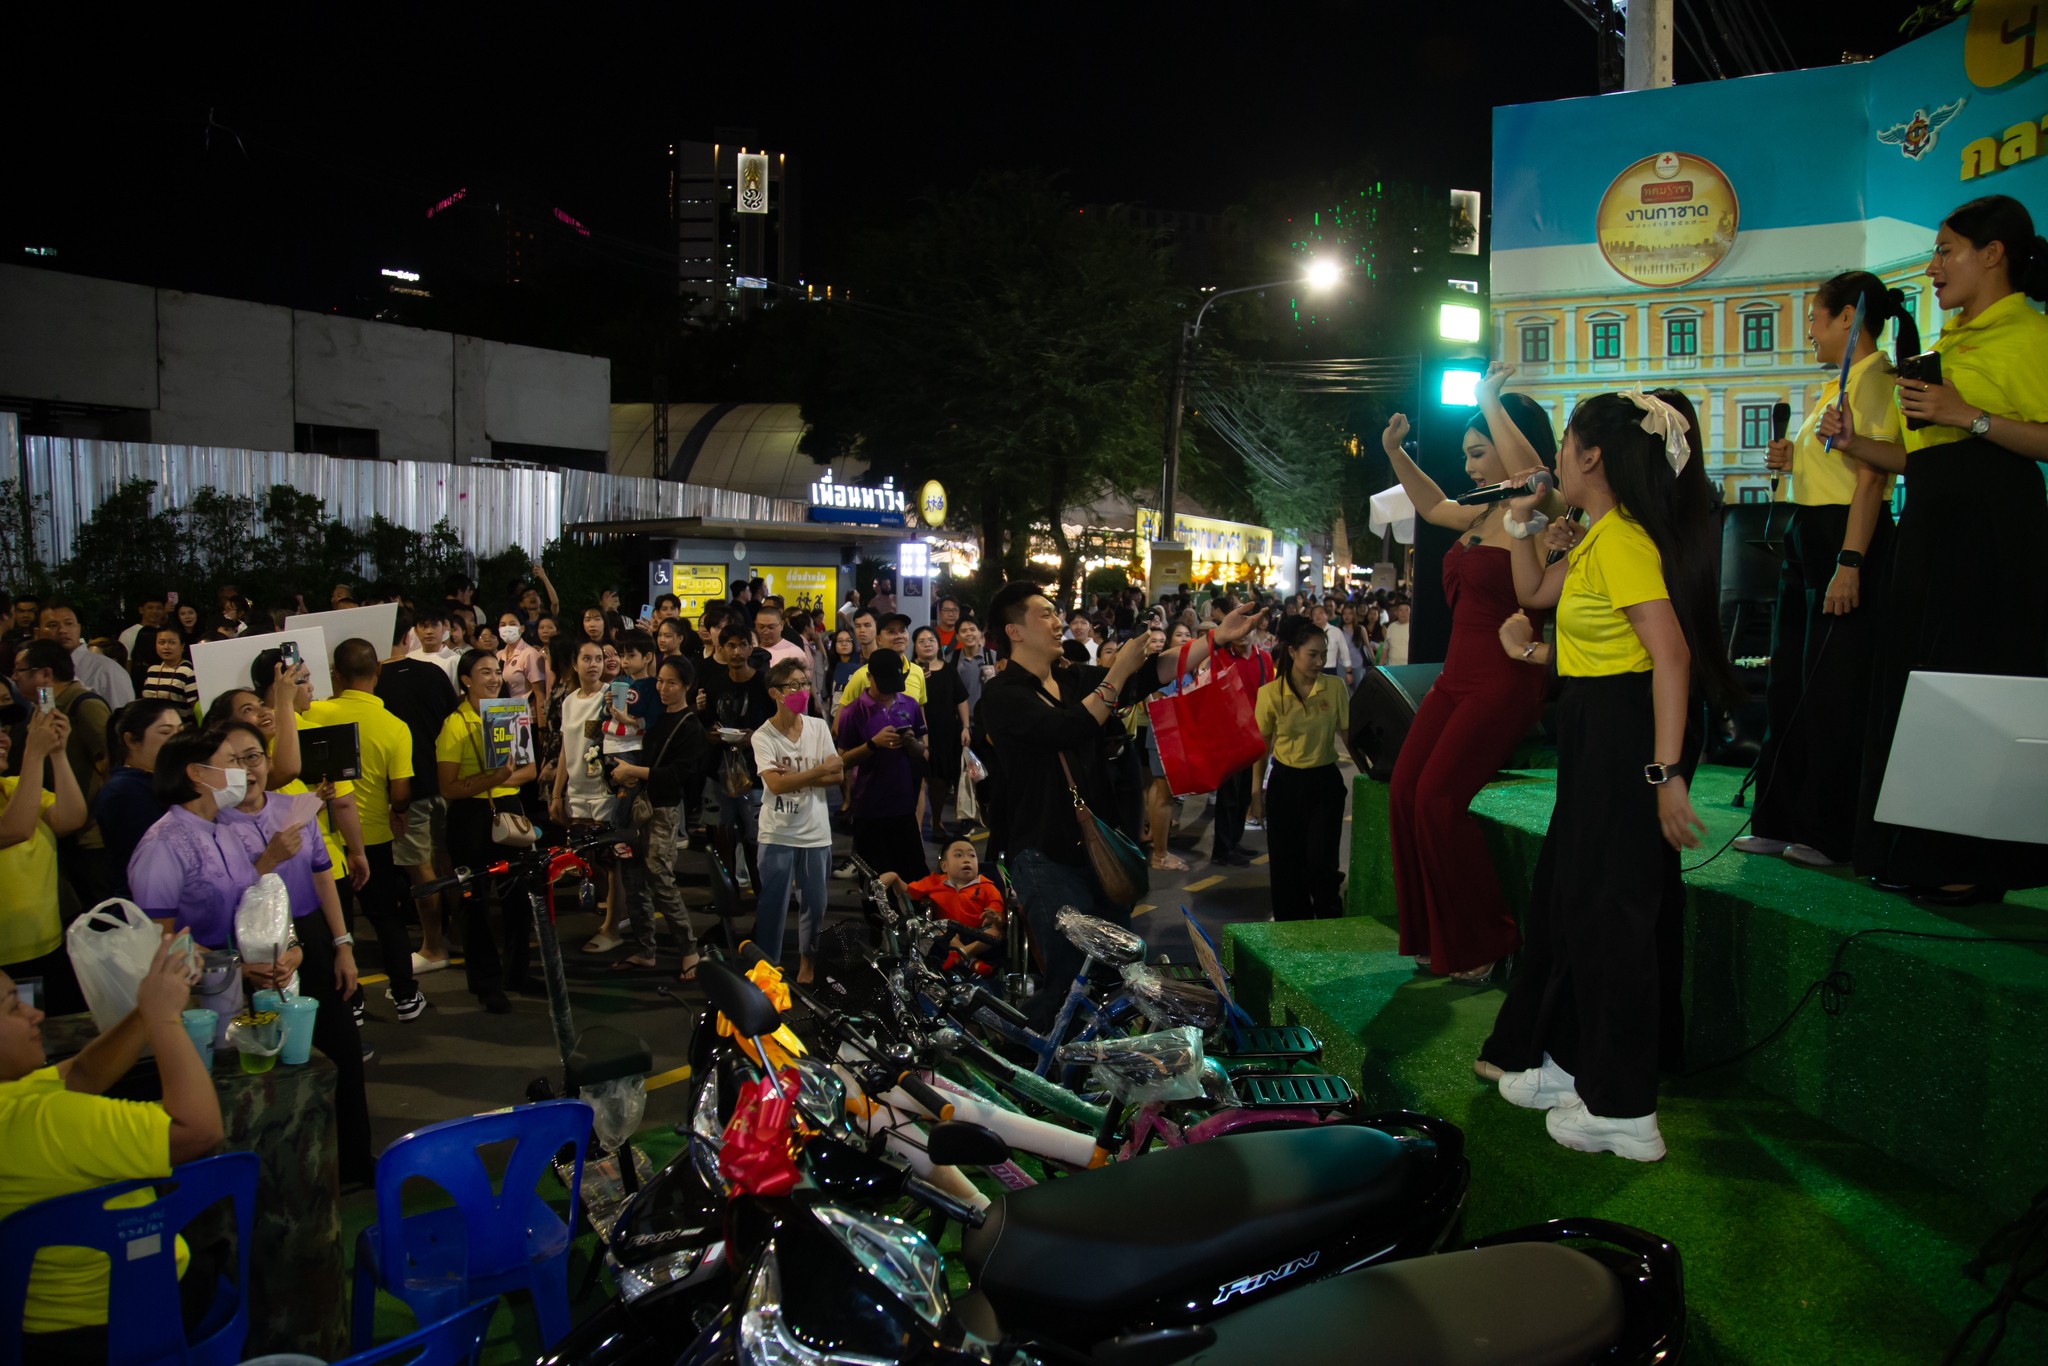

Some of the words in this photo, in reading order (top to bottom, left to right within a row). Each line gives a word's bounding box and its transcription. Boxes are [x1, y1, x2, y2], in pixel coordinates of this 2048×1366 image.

[1626, 204, 1709, 222] งานกาชาด
[812, 468, 905, 511] เพื่อนพาวิ่ง
[493, 727, 505, 743] 50
